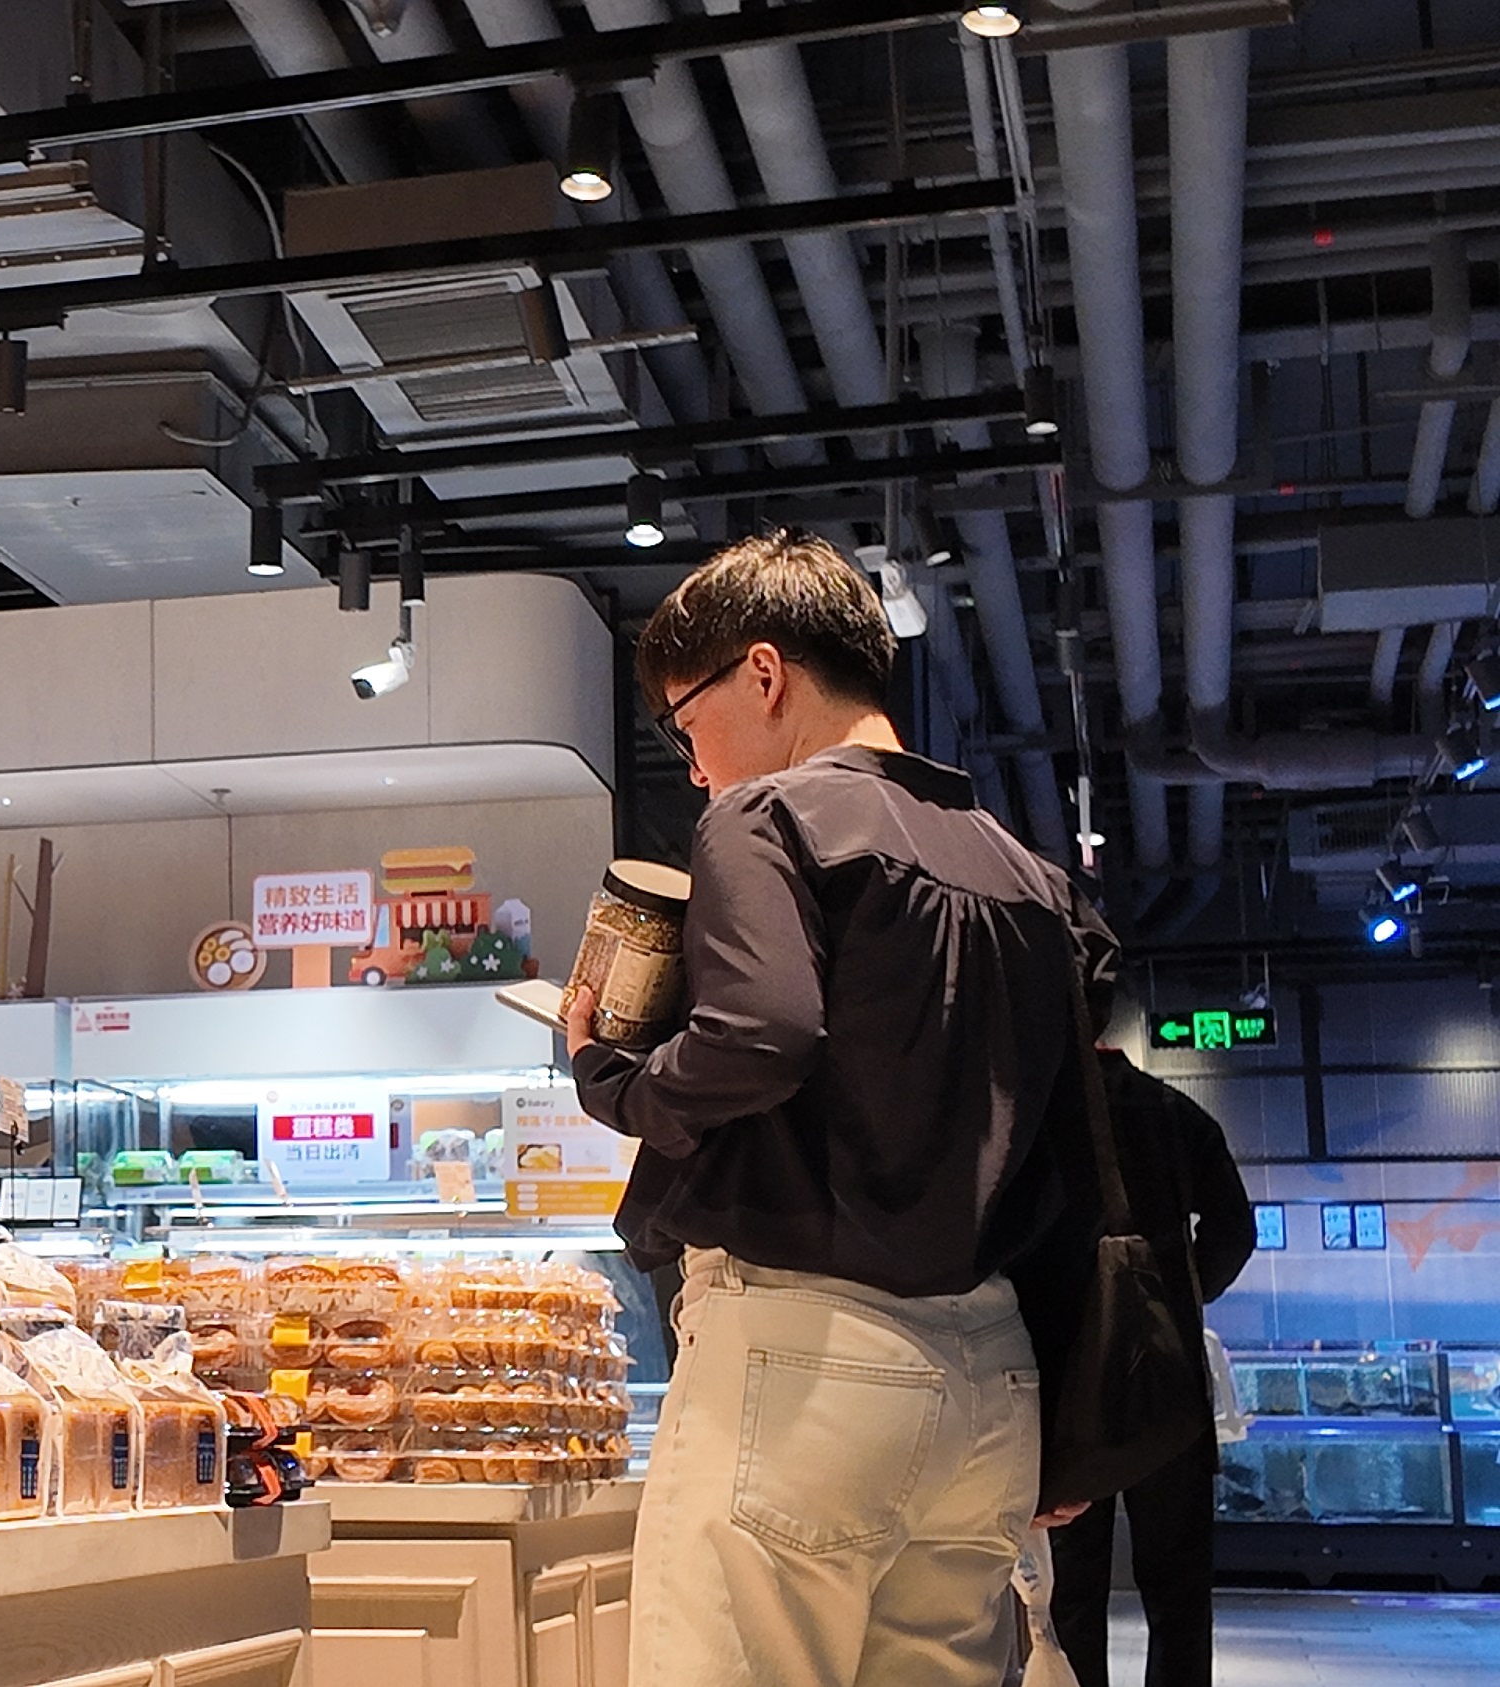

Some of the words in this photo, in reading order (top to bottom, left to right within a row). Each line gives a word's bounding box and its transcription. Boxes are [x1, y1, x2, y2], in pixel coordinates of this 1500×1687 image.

[265, 882, 359, 908] 精致生活
[258, 909, 366, 936] 营养好味道
